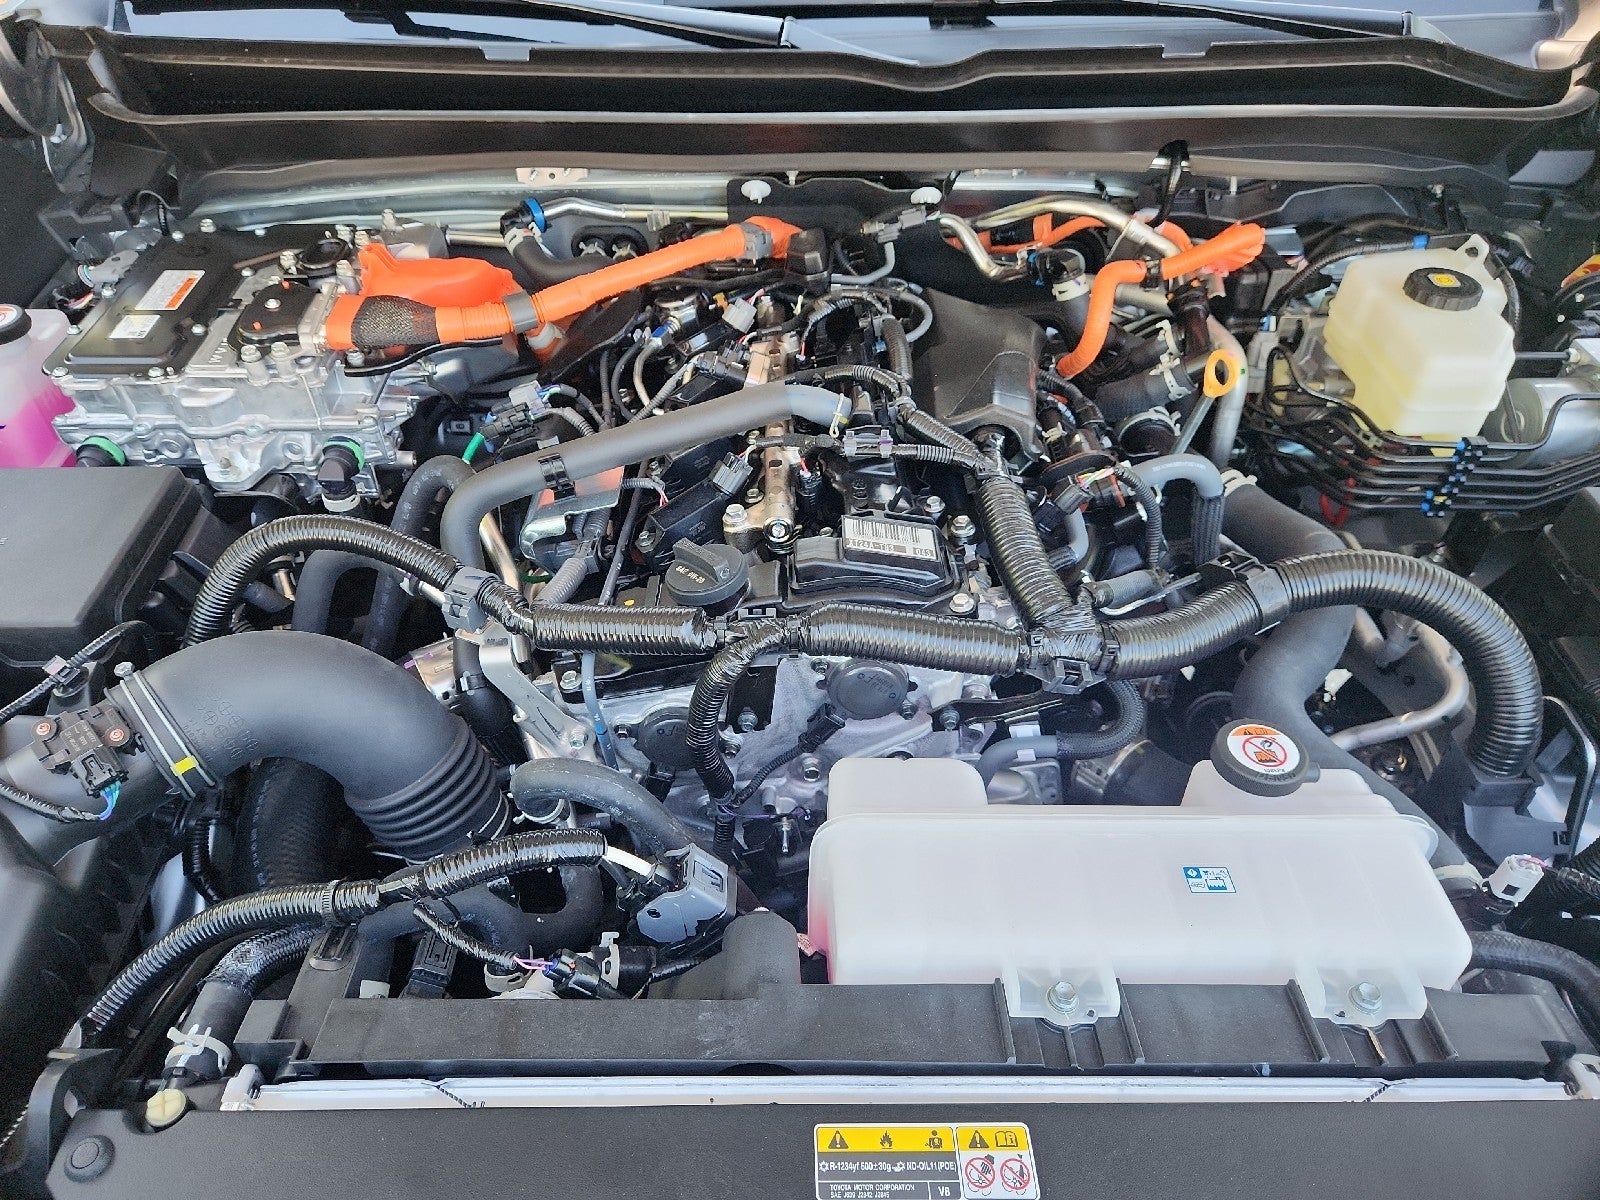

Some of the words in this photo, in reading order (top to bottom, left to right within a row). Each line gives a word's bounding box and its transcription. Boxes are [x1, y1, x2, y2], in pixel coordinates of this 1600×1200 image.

[829, 1161, 860, 1173] R-1234yf
[829, 1183, 852, 1191] TOYOTA
[853, 1183, 874, 1191] MOTOR
[875, 1183, 915, 1191] CORPORATION
[830, 1191, 842, 1199] SAE
